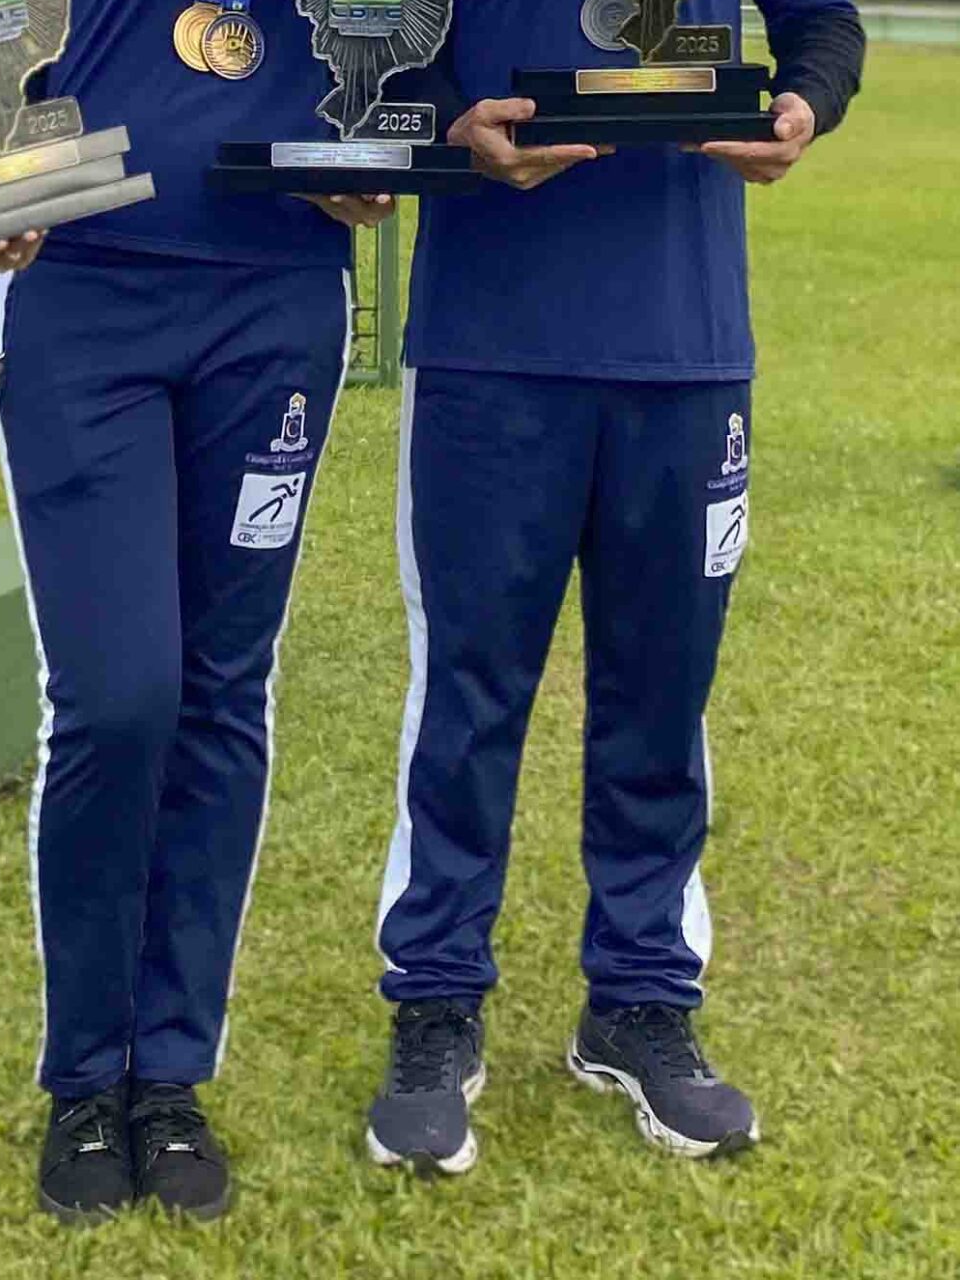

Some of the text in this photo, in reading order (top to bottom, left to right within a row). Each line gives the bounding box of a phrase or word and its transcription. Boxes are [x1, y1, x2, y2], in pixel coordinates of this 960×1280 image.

[674, 35, 720, 53] 2025
[28, 109, 68, 135] 2025
[377, 113, 423, 132] 2025
